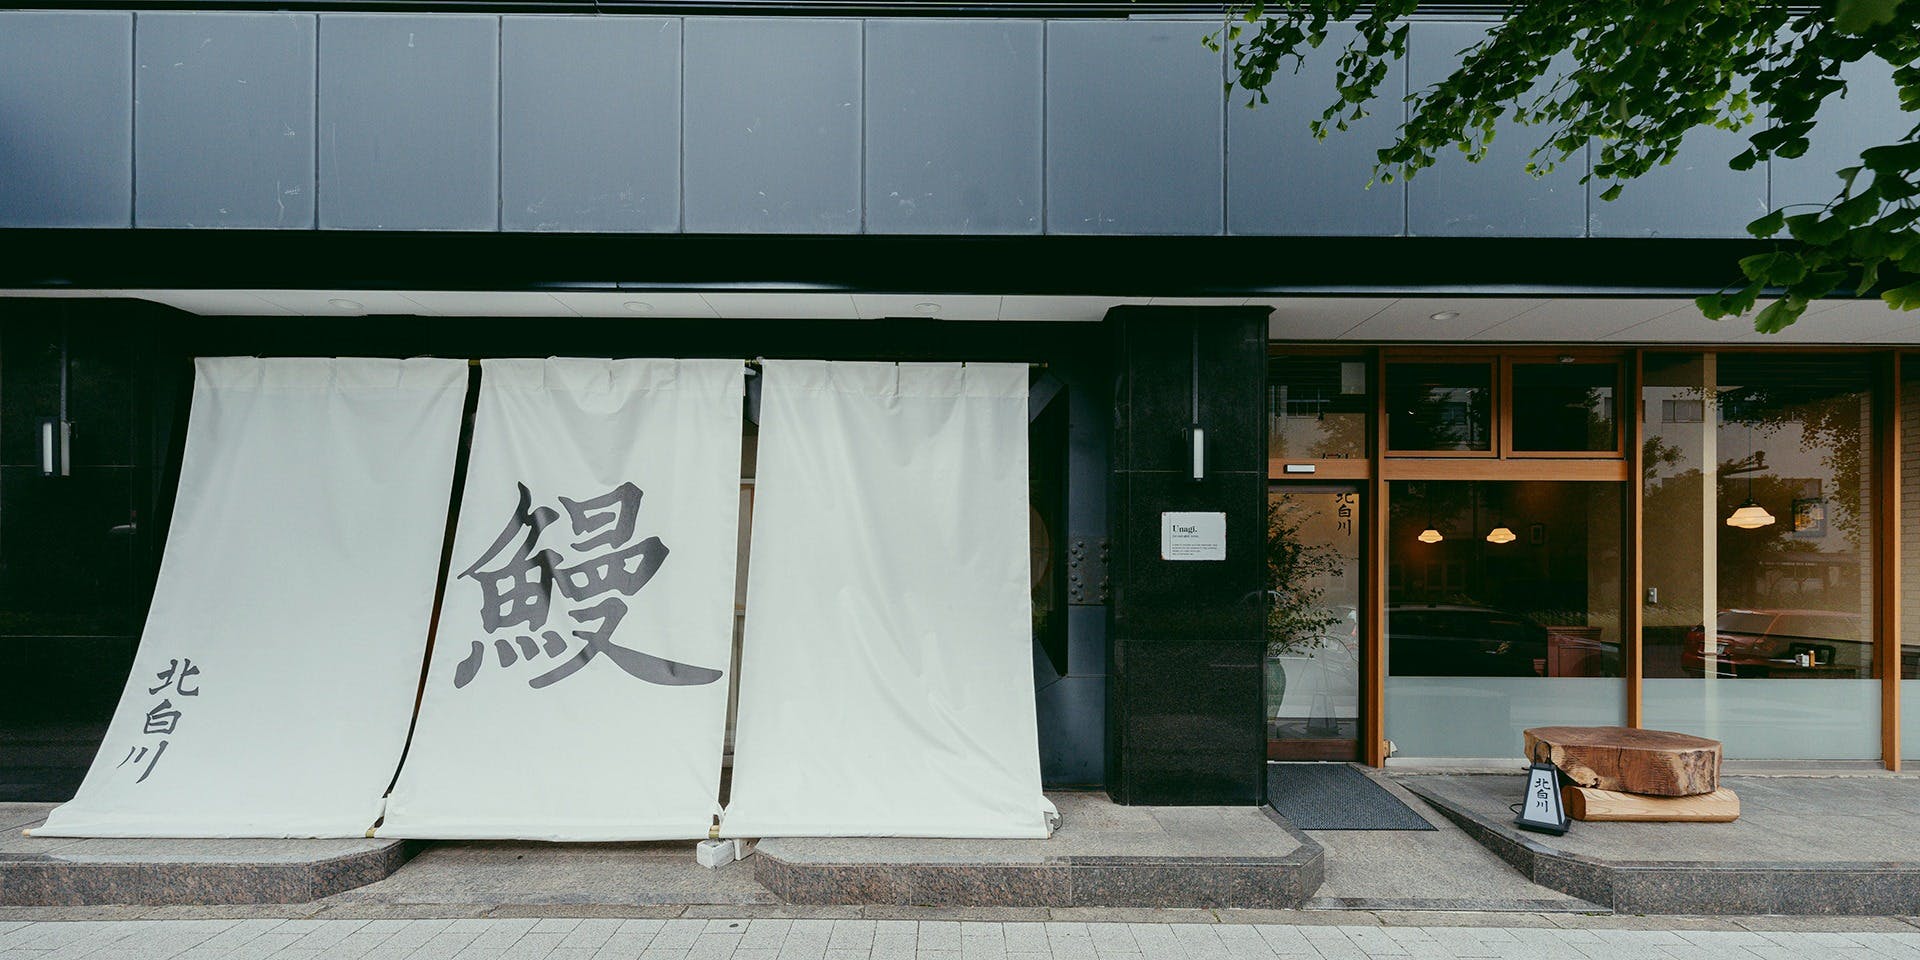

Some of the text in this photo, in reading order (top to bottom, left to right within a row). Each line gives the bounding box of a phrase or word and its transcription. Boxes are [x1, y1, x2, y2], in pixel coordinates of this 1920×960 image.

[454, 481, 723, 689] 鰻
[117, 658, 200, 784] 北白川
[1535, 778, 1550, 813] 北白川
